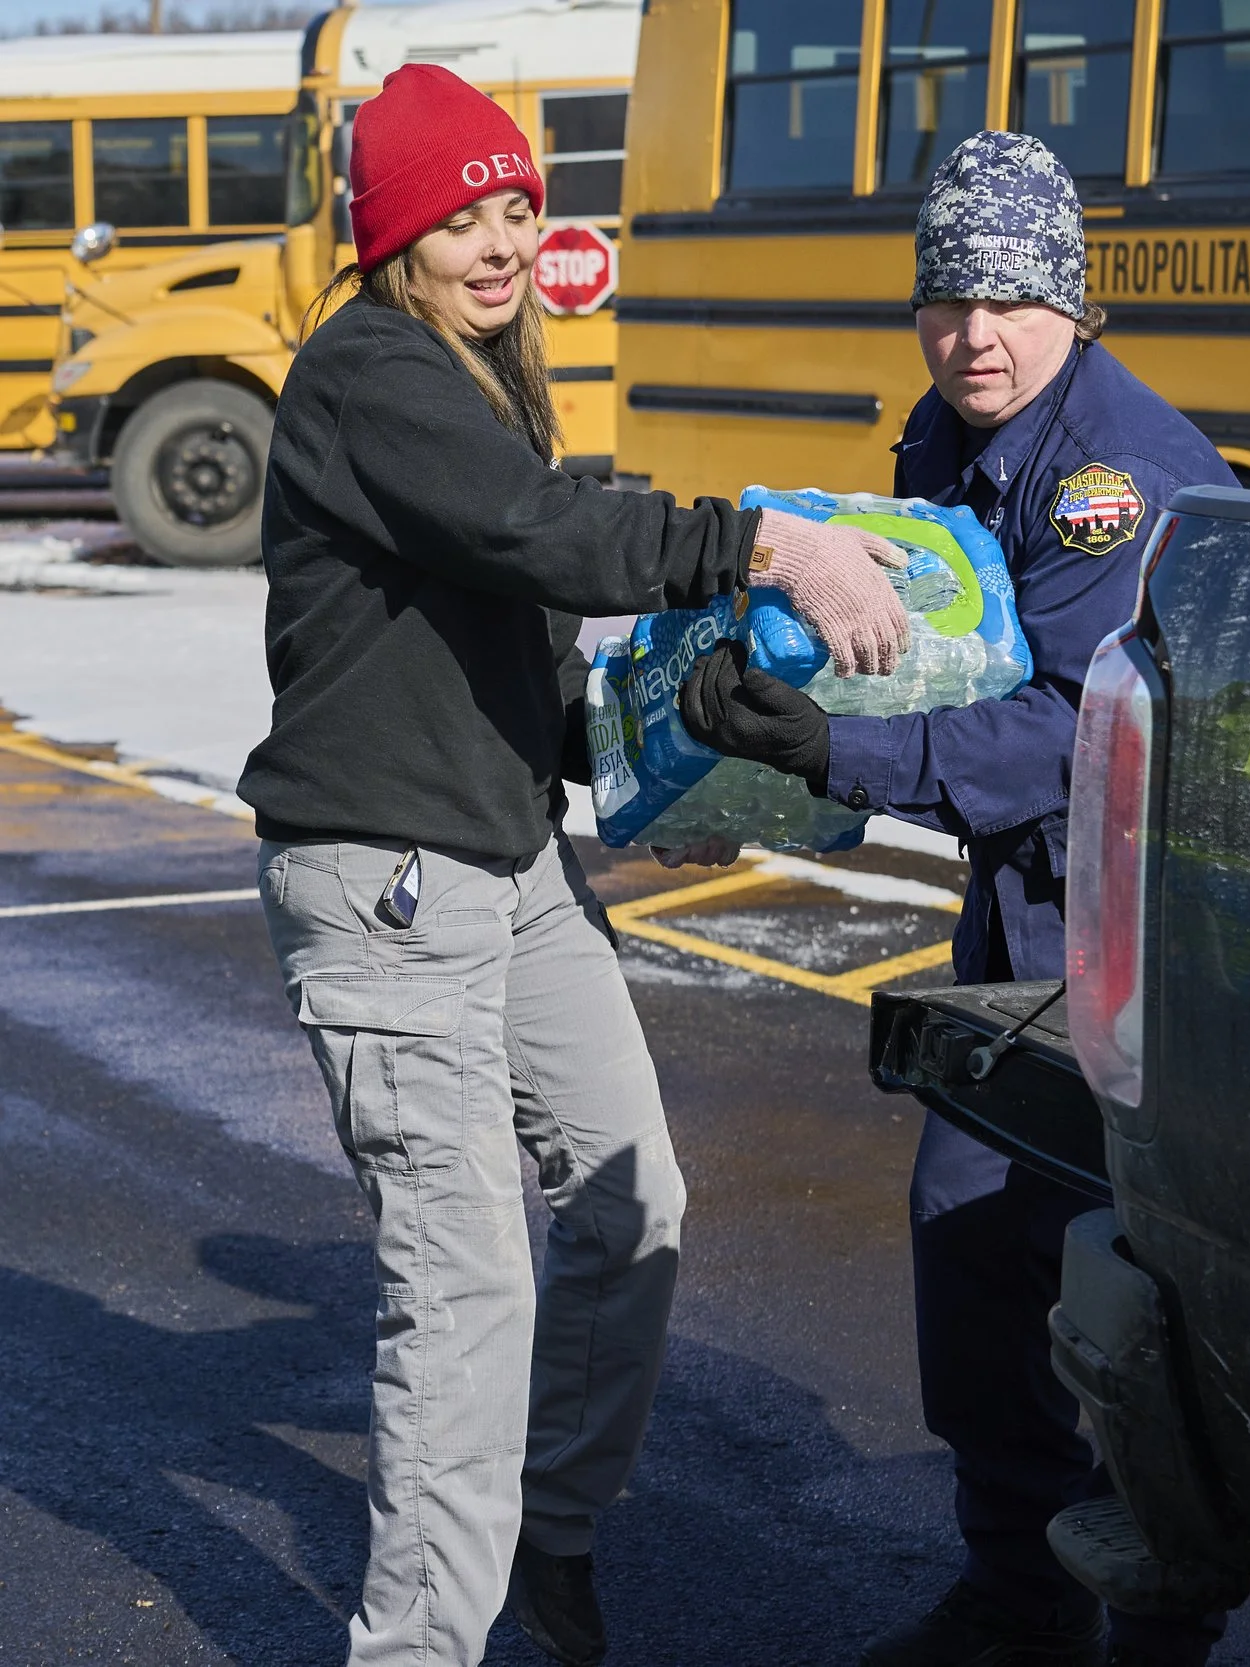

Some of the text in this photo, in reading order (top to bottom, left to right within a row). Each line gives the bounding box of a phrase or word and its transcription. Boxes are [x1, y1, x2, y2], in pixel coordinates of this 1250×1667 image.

[462, 153, 538, 187] OEM
[968, 234, 1034, 254] NASHVILLE
[538, 249, 605, 287] STOP
[979, 249, 1022, 271] FIRE
[1067, 471, 1124, 492] NASHVILLE
[1069, 486, 1124, 502] FIRE DEPARTMENT
[1087, 533, 1111, 544] 1860
[645, 707, 667, 728] AGUA
[600, 749, 624, 775] ESTA
